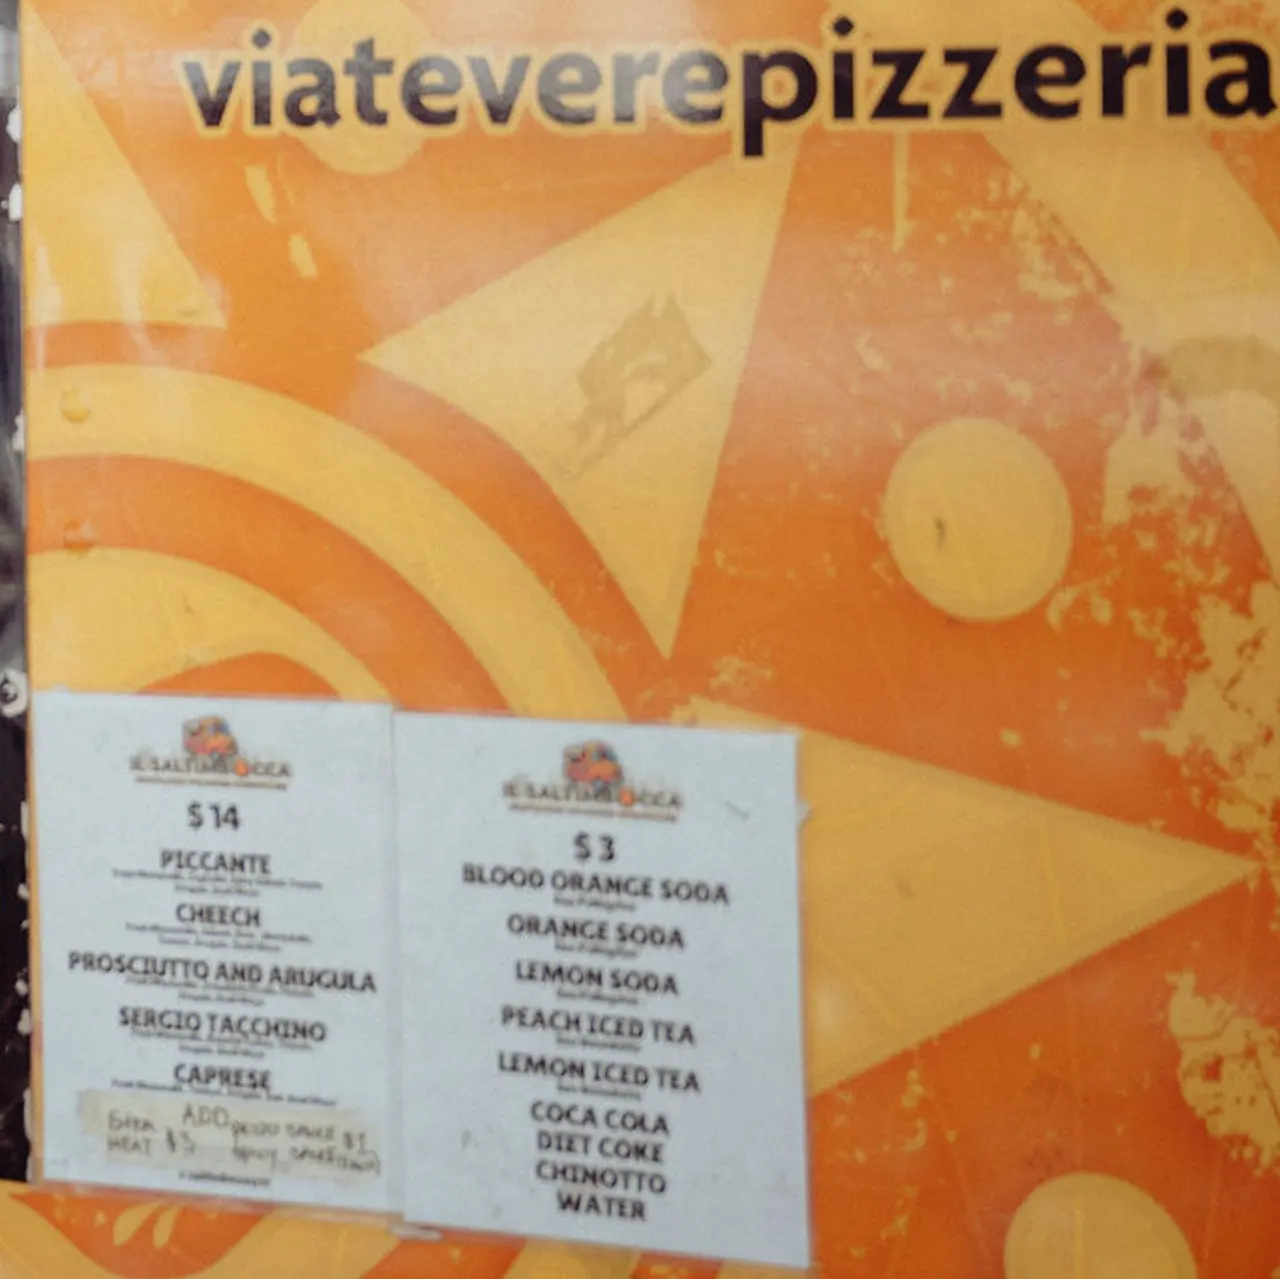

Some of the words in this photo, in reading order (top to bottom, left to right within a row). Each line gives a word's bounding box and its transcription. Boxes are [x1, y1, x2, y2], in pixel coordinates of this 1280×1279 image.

[181, 5, 1278, 158] viateverepizzeria
[159, 847, 272, 875] PICCANTE
[461, 863, 544, 889] BLOOD
[550, 870, 654, 898] ORANGE
[660, 878, 731, 905] SODA
[176, 902, 261, 927] CHEECH
[506, 913, 609, 941] ORANGE
[615, 921, 686, 949] SODA
[216, 961, 263, 983] AND
[269, 964, 377, 993] ARUGULA
[515, 959, 603, 987] LEMON
[609, 966, 679, 995] SODA
[119, 1005, 201, 1033] SERGIO
[207, 1011, 327, 1042] TACCHINO
[500, 1004, 581, 1031] PEACH
[587, 1012, 645, 1038] ICED
[651, 1019, 697, 1045] TEA
[173, 1063, 273, 1089] CAPRESE
[497, 1051, 586, 1078] LEMON
[592, 1060, 650, 1086] ICED
[655, 1066, 702, 1093] TEA
[530, 1099, 599, 1128] COCA
[605, 1108, 670, 1137] COLA
[536, 1129, 592, 1155] DIET
[598, 1135, 665, 1164] COKE
[535, 1159, 668, 1194] CHINOTTO
[556, 1191, 646, 1220] WATER
